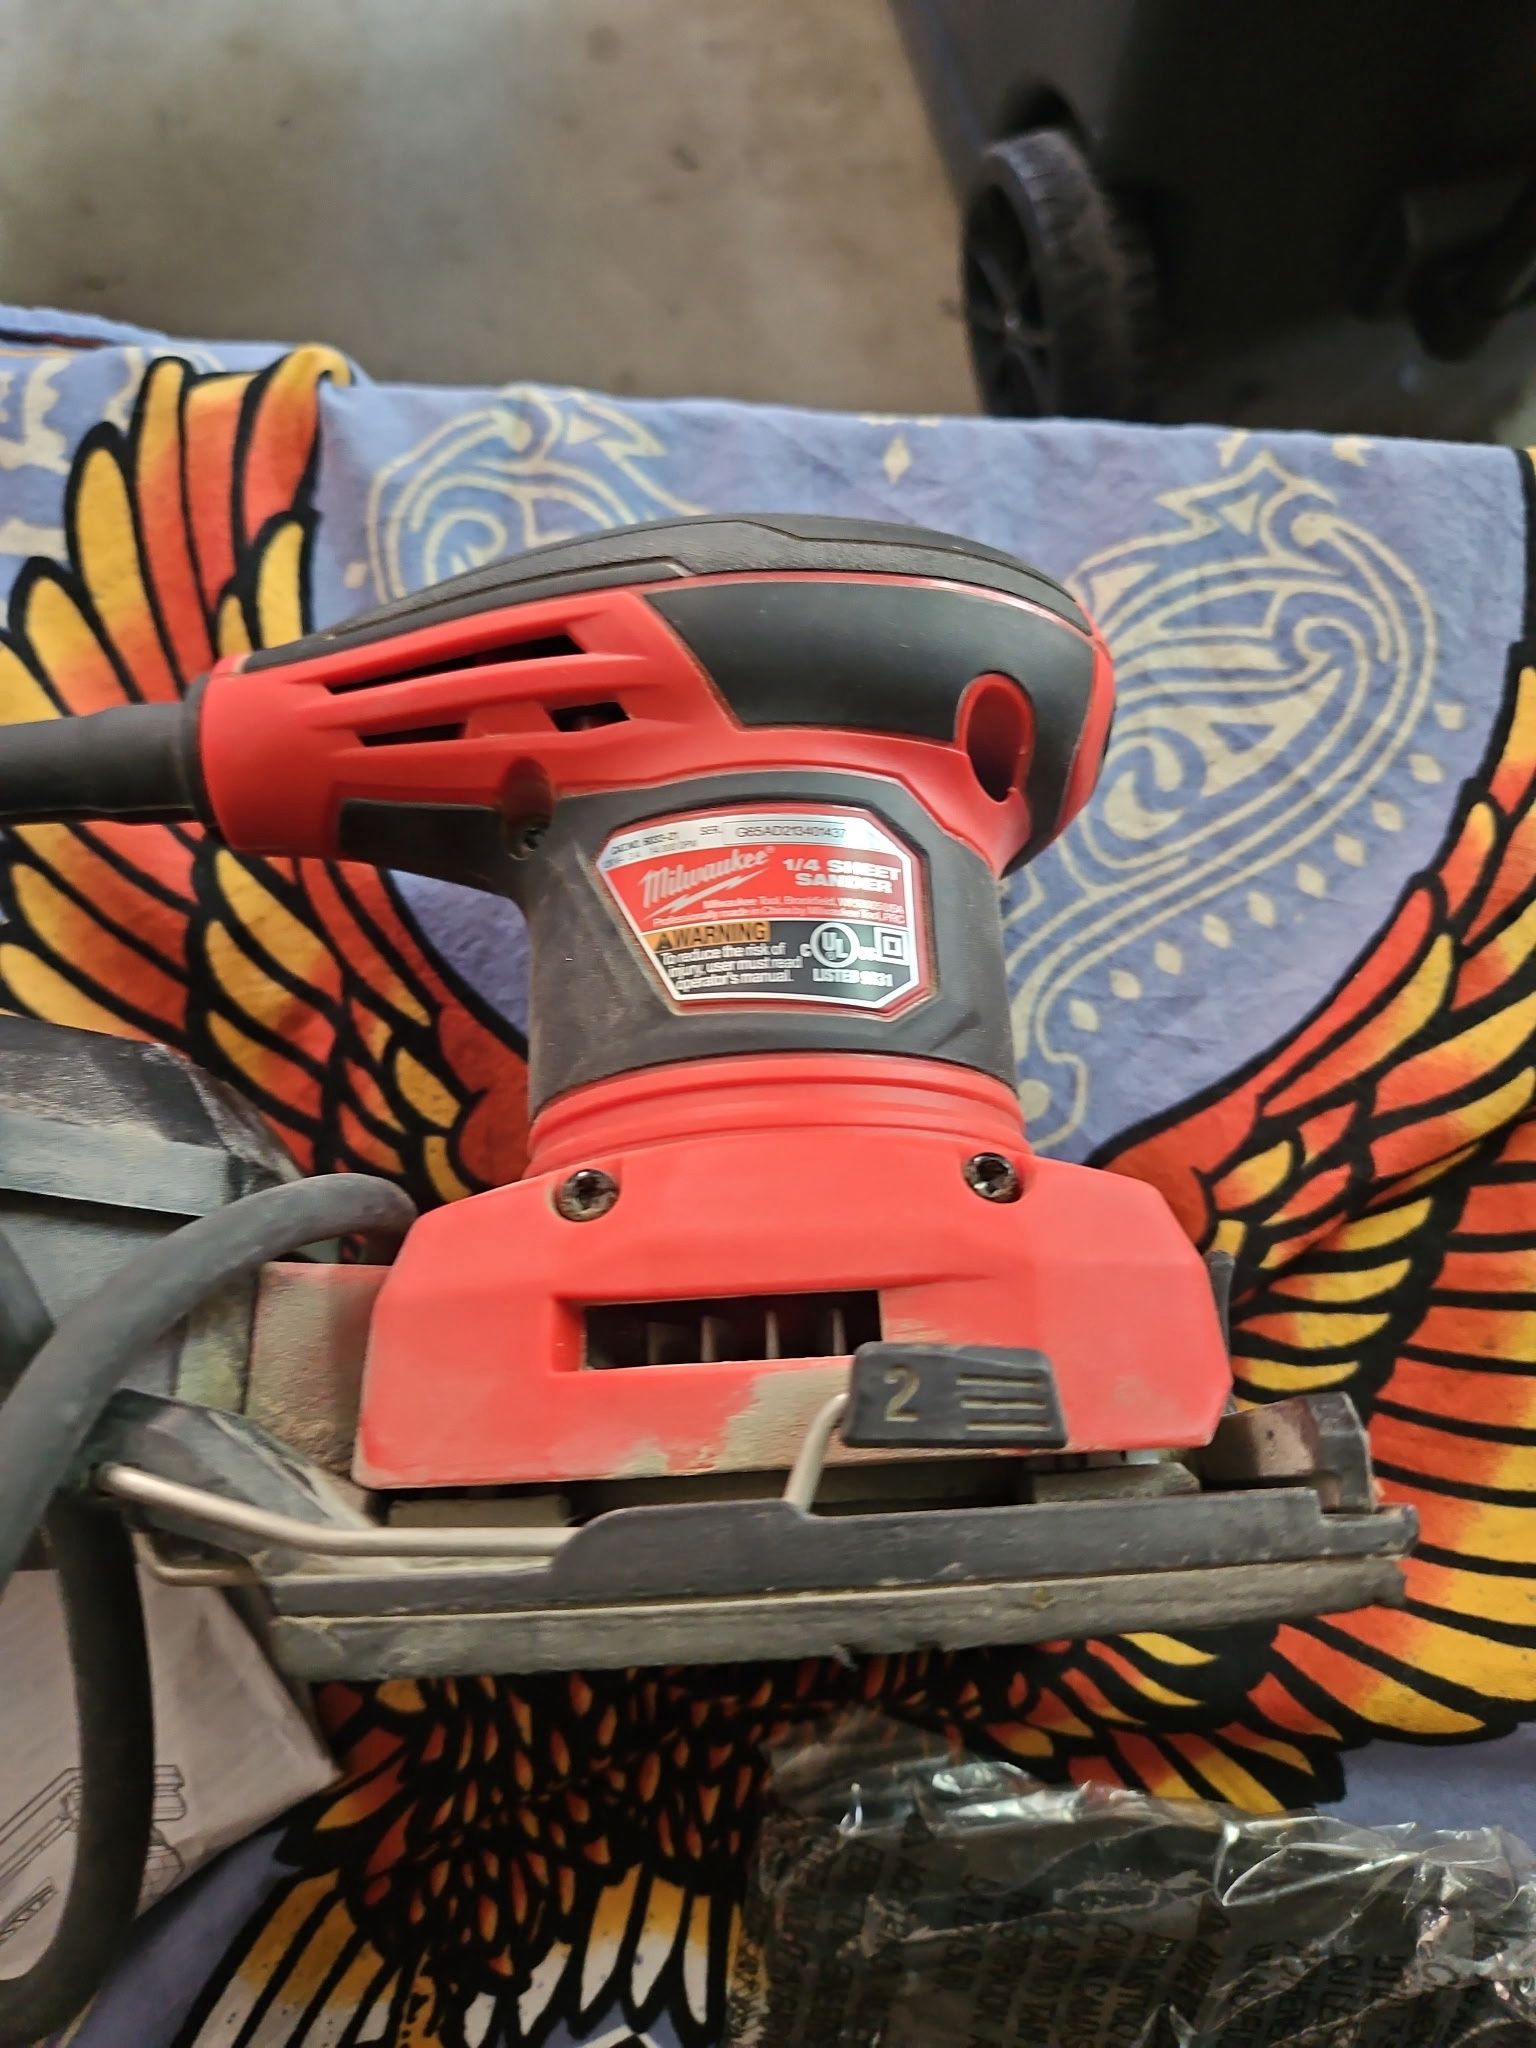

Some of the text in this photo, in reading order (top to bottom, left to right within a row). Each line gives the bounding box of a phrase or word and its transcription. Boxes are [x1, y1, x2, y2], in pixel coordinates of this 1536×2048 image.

[636, 848, 769, 909] Milwaukee
[783, 858, 902, 881] 1/4 SHEET
[794, 873, 893, 893] SANDER
[673, 922, 766, 947] WARNING
[660, 952, 676, 965] To
[722, 945, 744, 958] the
[745, 943, 770, 956] risk
[771, 942, 787, 955] of
[736, 957, 770, 970] must
[771, 956, 803, 968] read
[883, 1363, 920, 1422] 2
